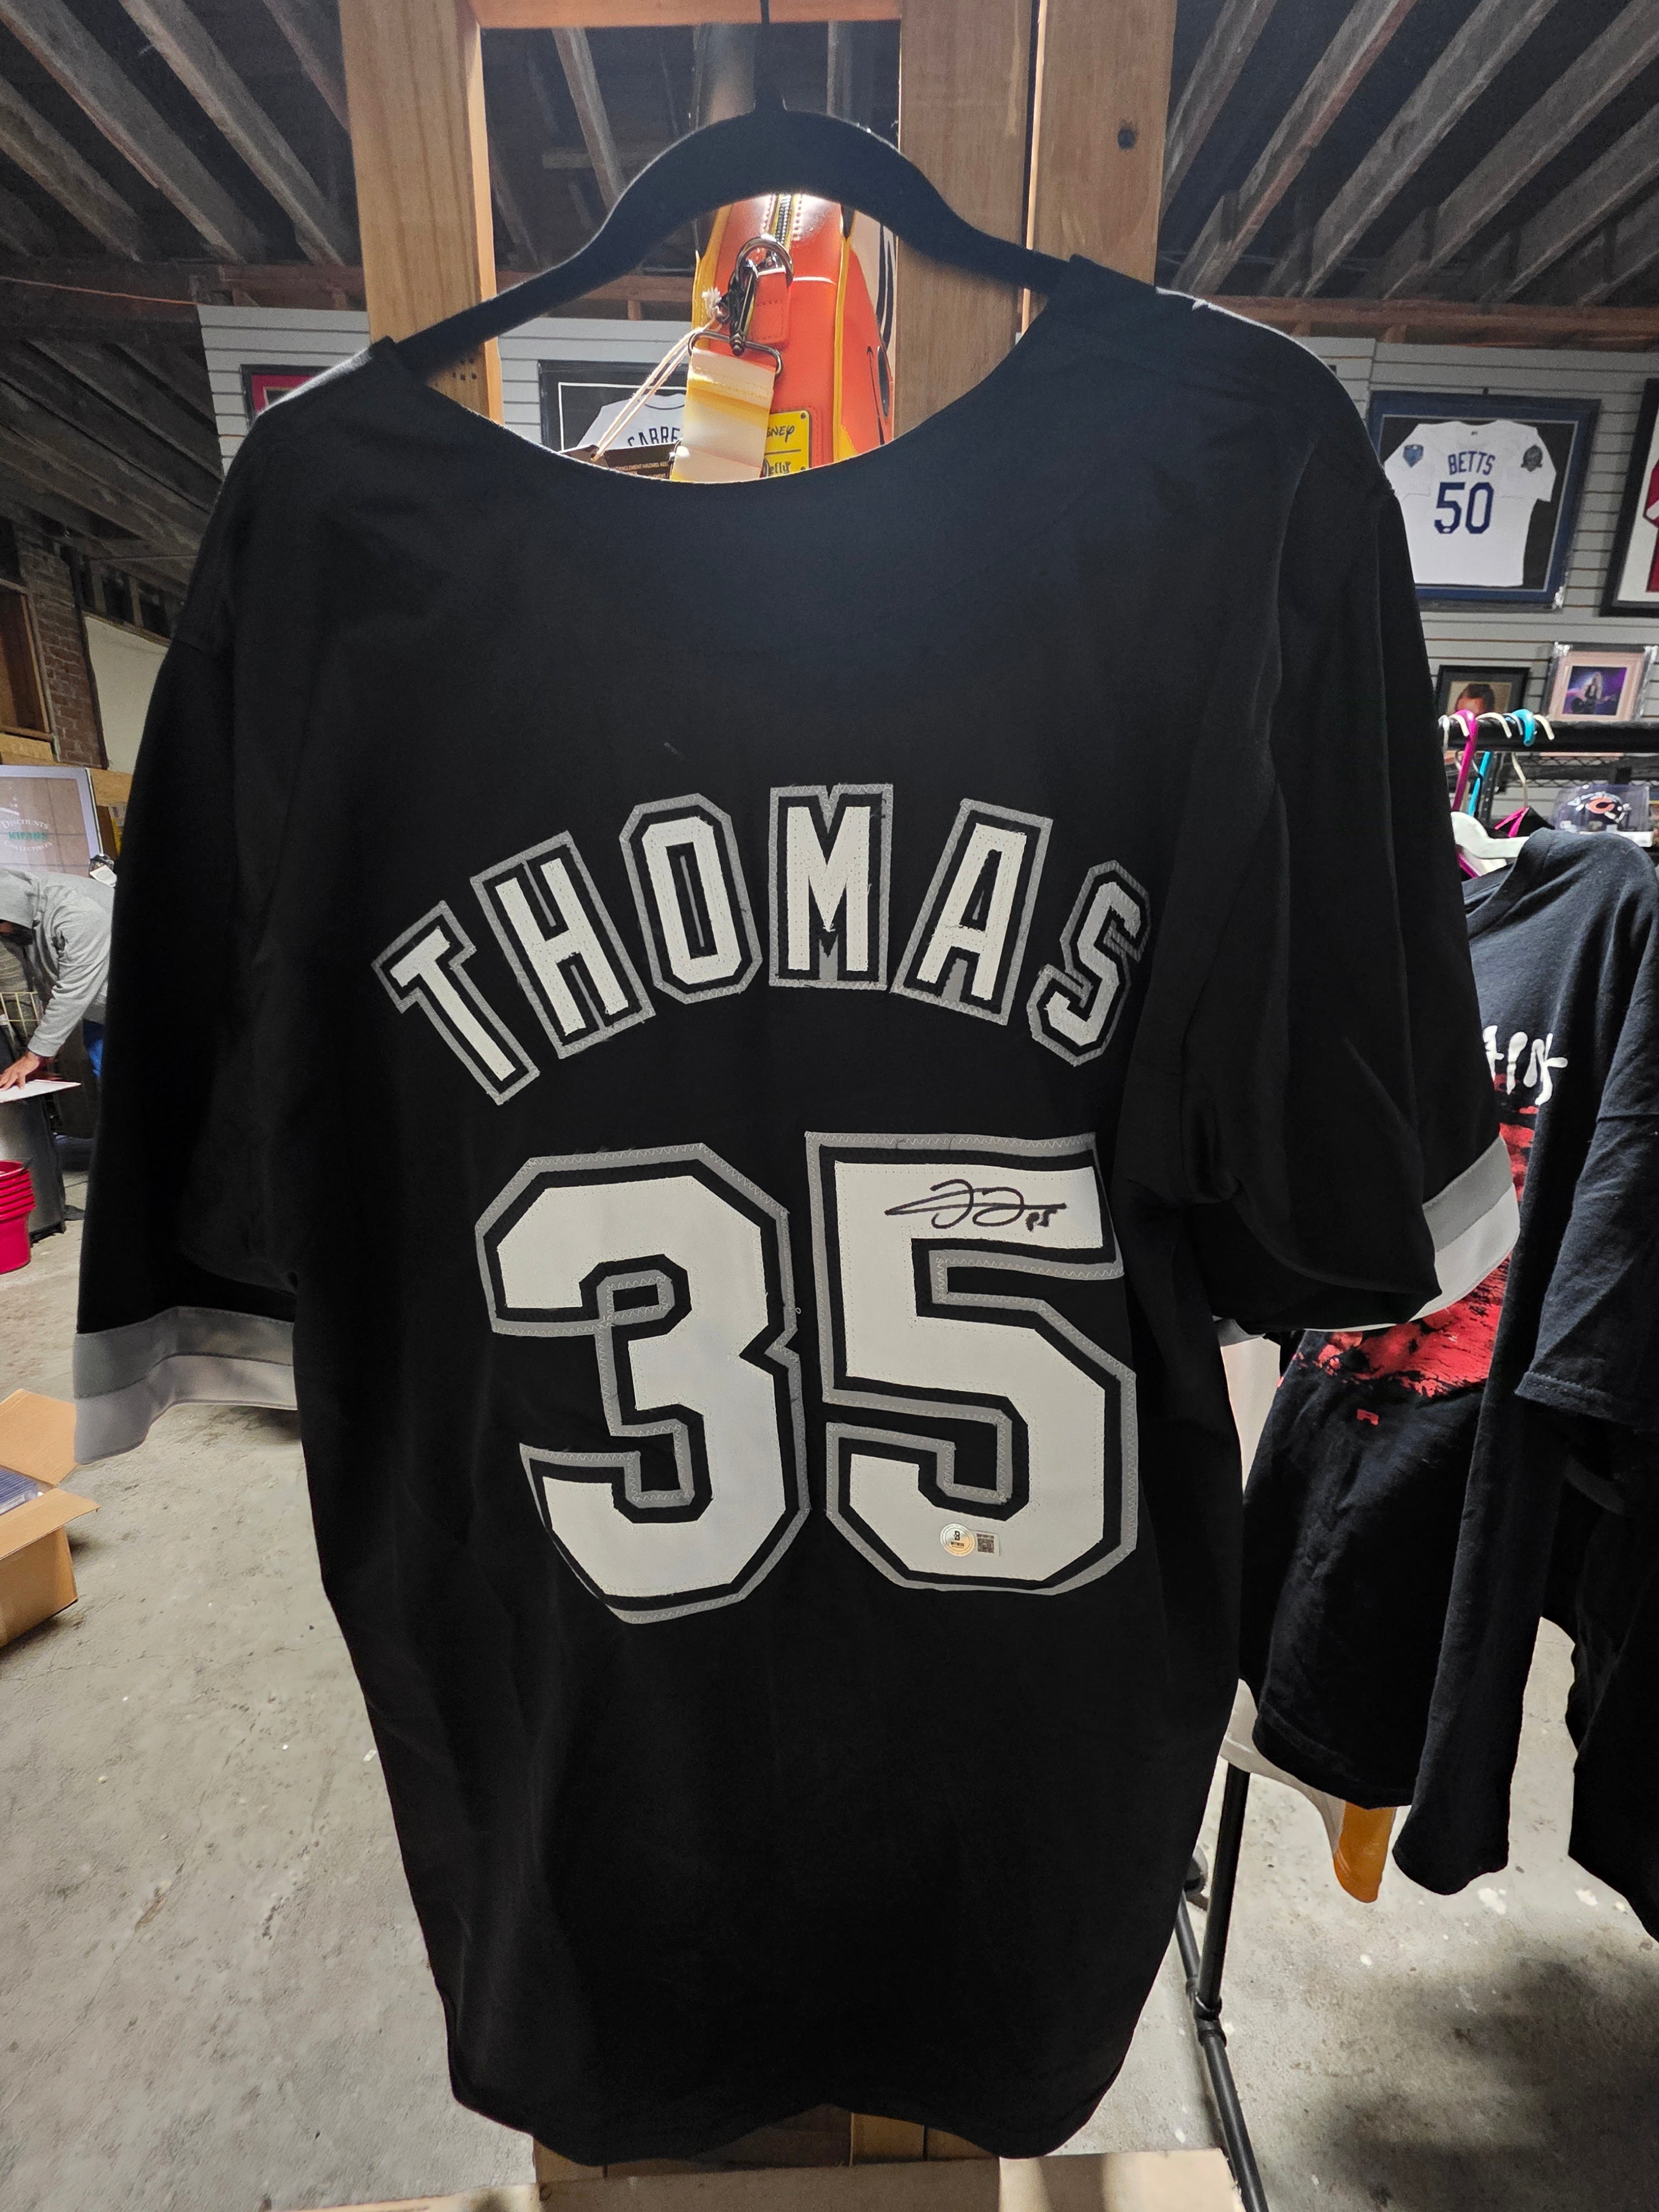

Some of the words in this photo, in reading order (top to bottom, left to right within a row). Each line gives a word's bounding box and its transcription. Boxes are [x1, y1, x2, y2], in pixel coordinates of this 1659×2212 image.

[1434, 482, 1494, 534] 50
[1448, 451, 1496, 476] BETTS
[370, 782, 1152, 1106] THOMAS
[474, 1130, 1138, 1625] 35
